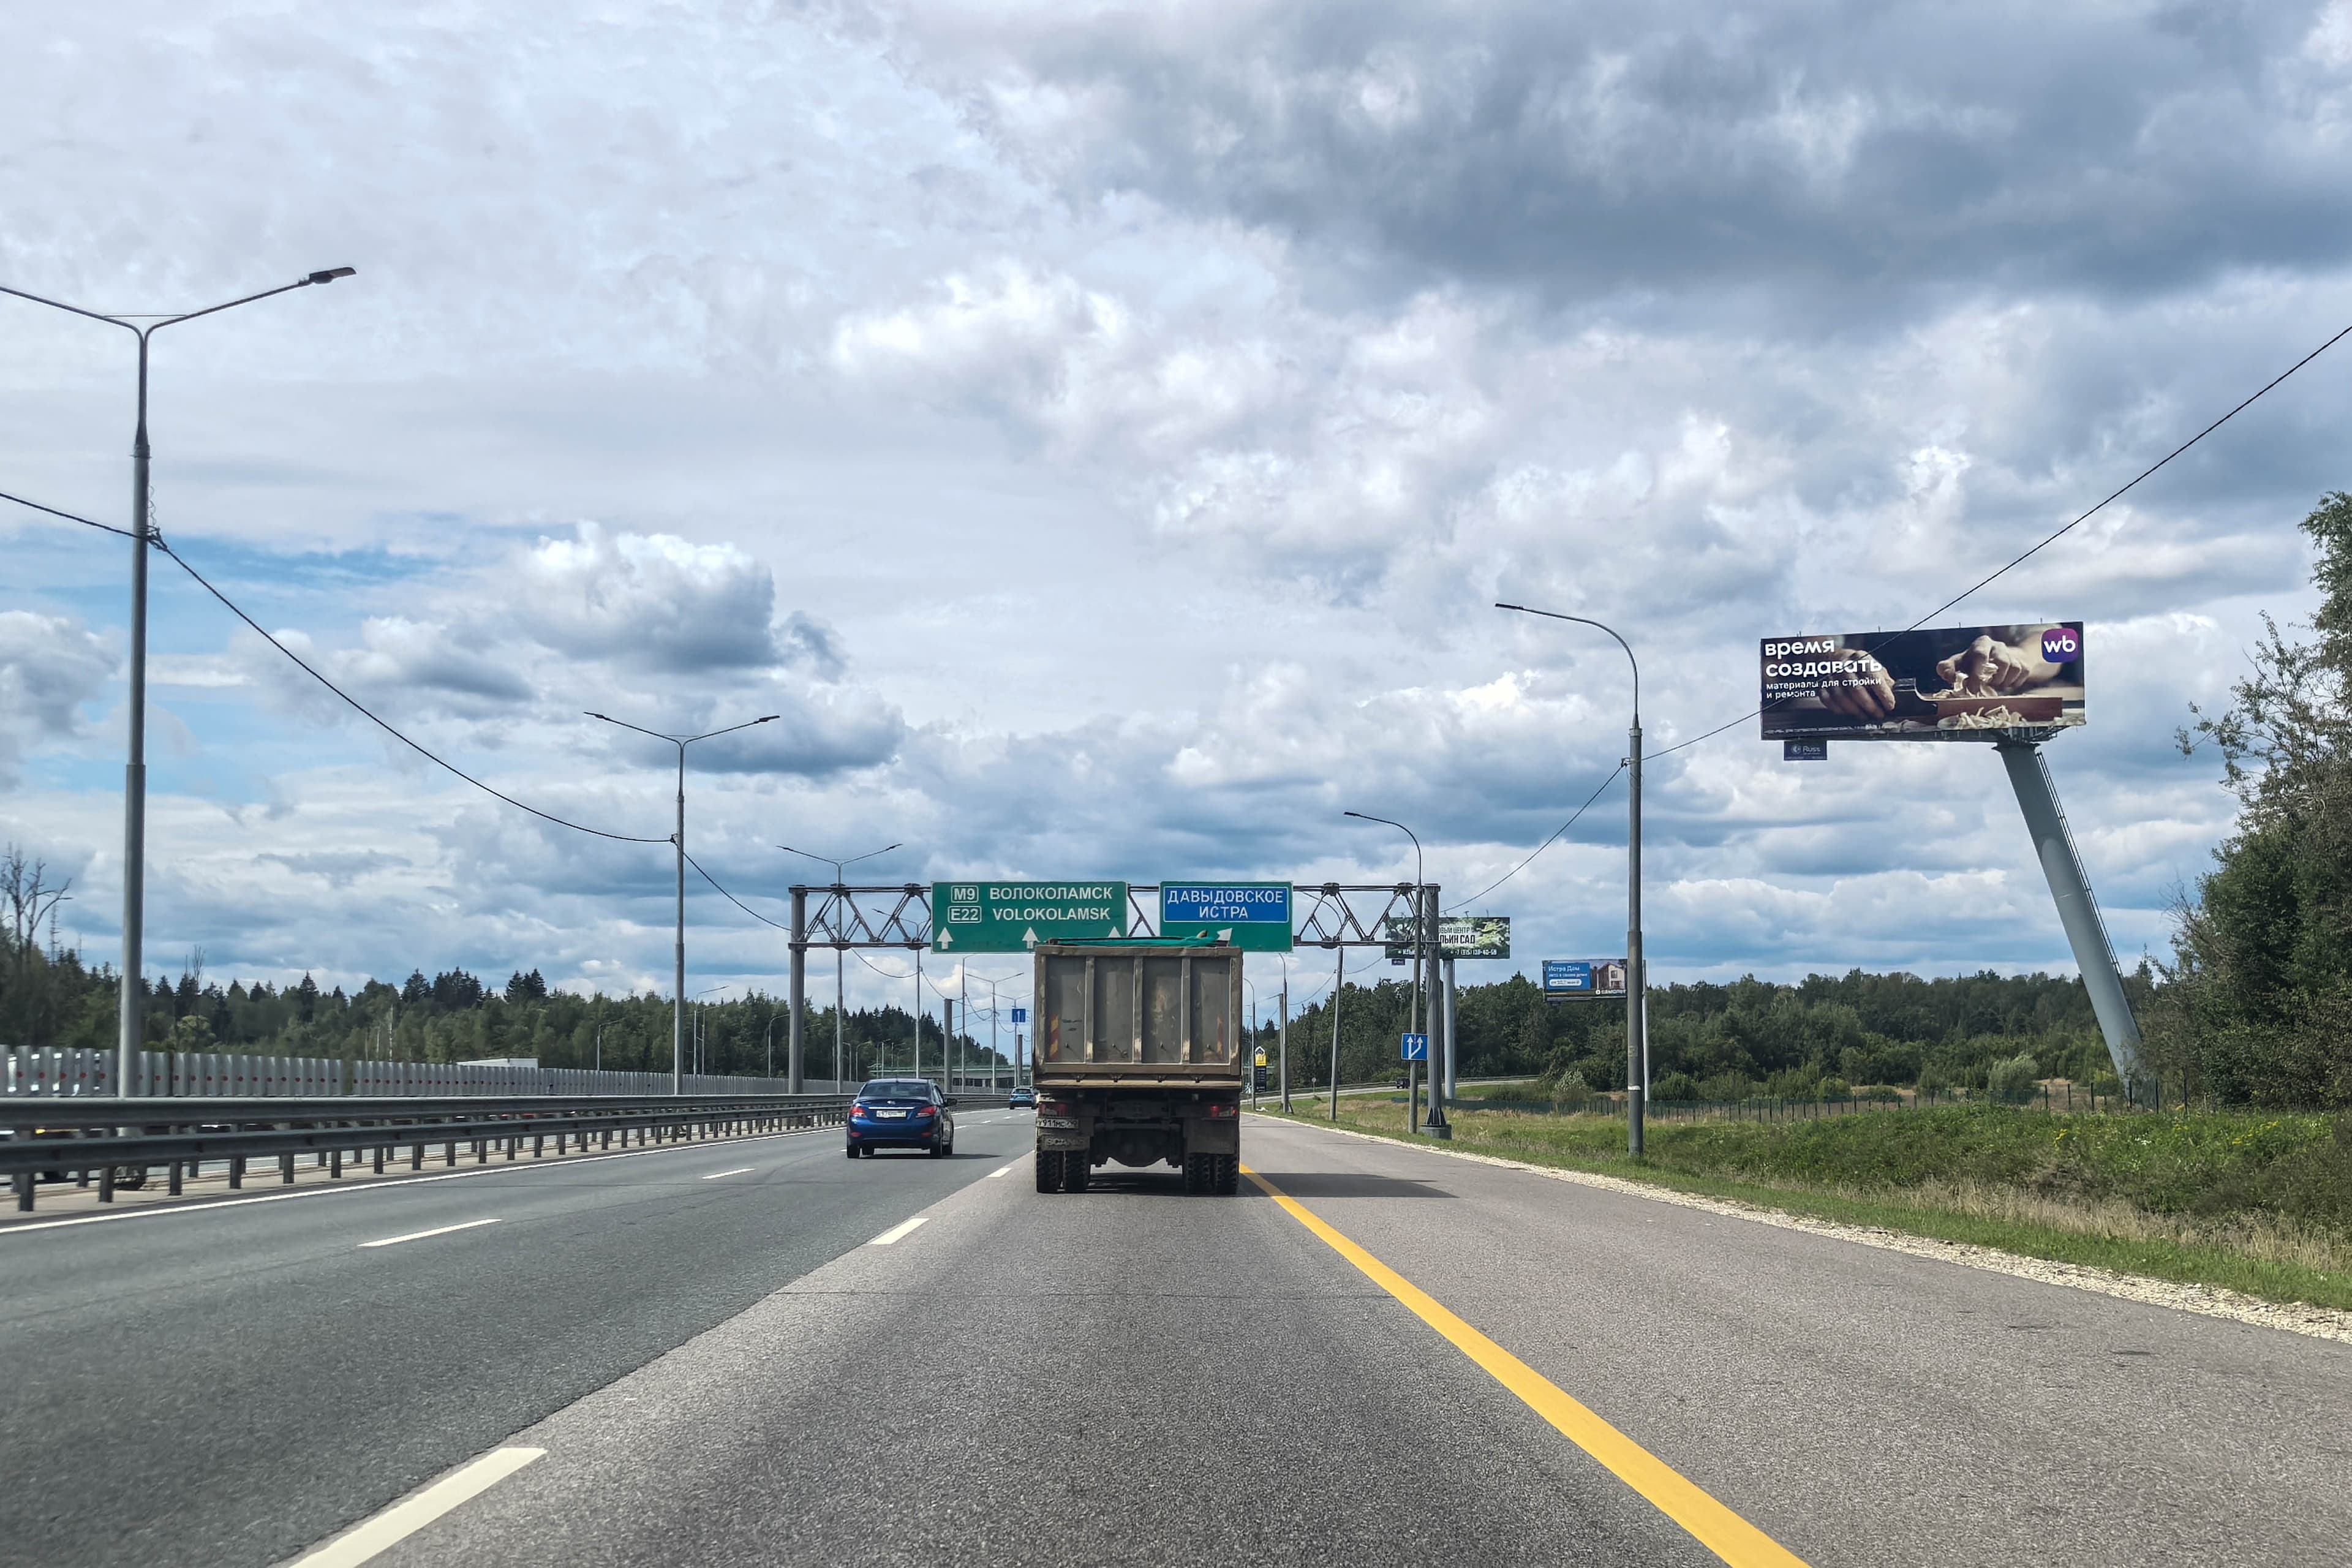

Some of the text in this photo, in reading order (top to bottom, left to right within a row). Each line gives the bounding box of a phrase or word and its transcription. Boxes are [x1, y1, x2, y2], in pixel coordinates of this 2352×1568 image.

[1765, 640, 1835, 660] время
[2043, 635, 2076, 654] wb
[1765, 660, 1883, 677] создавать
[1766, 677, 1881, 690] материалы для стройки
[1775, 690, 1815, 700] ремонта
[954, 887, 1113, 900] М9 ВОЛОКОЛАМСК
[1167, 890, 1283, 905] ДАВЫДОВСКОЕ
[951, 907, 1110, 921] E22 VOLOKOLAMSK
[1199, 906, 1248, 919] ИСТРА
[1453, 925, 1471, 934] ЦЕНТР
[1460, 935, 1476, 944] САД
